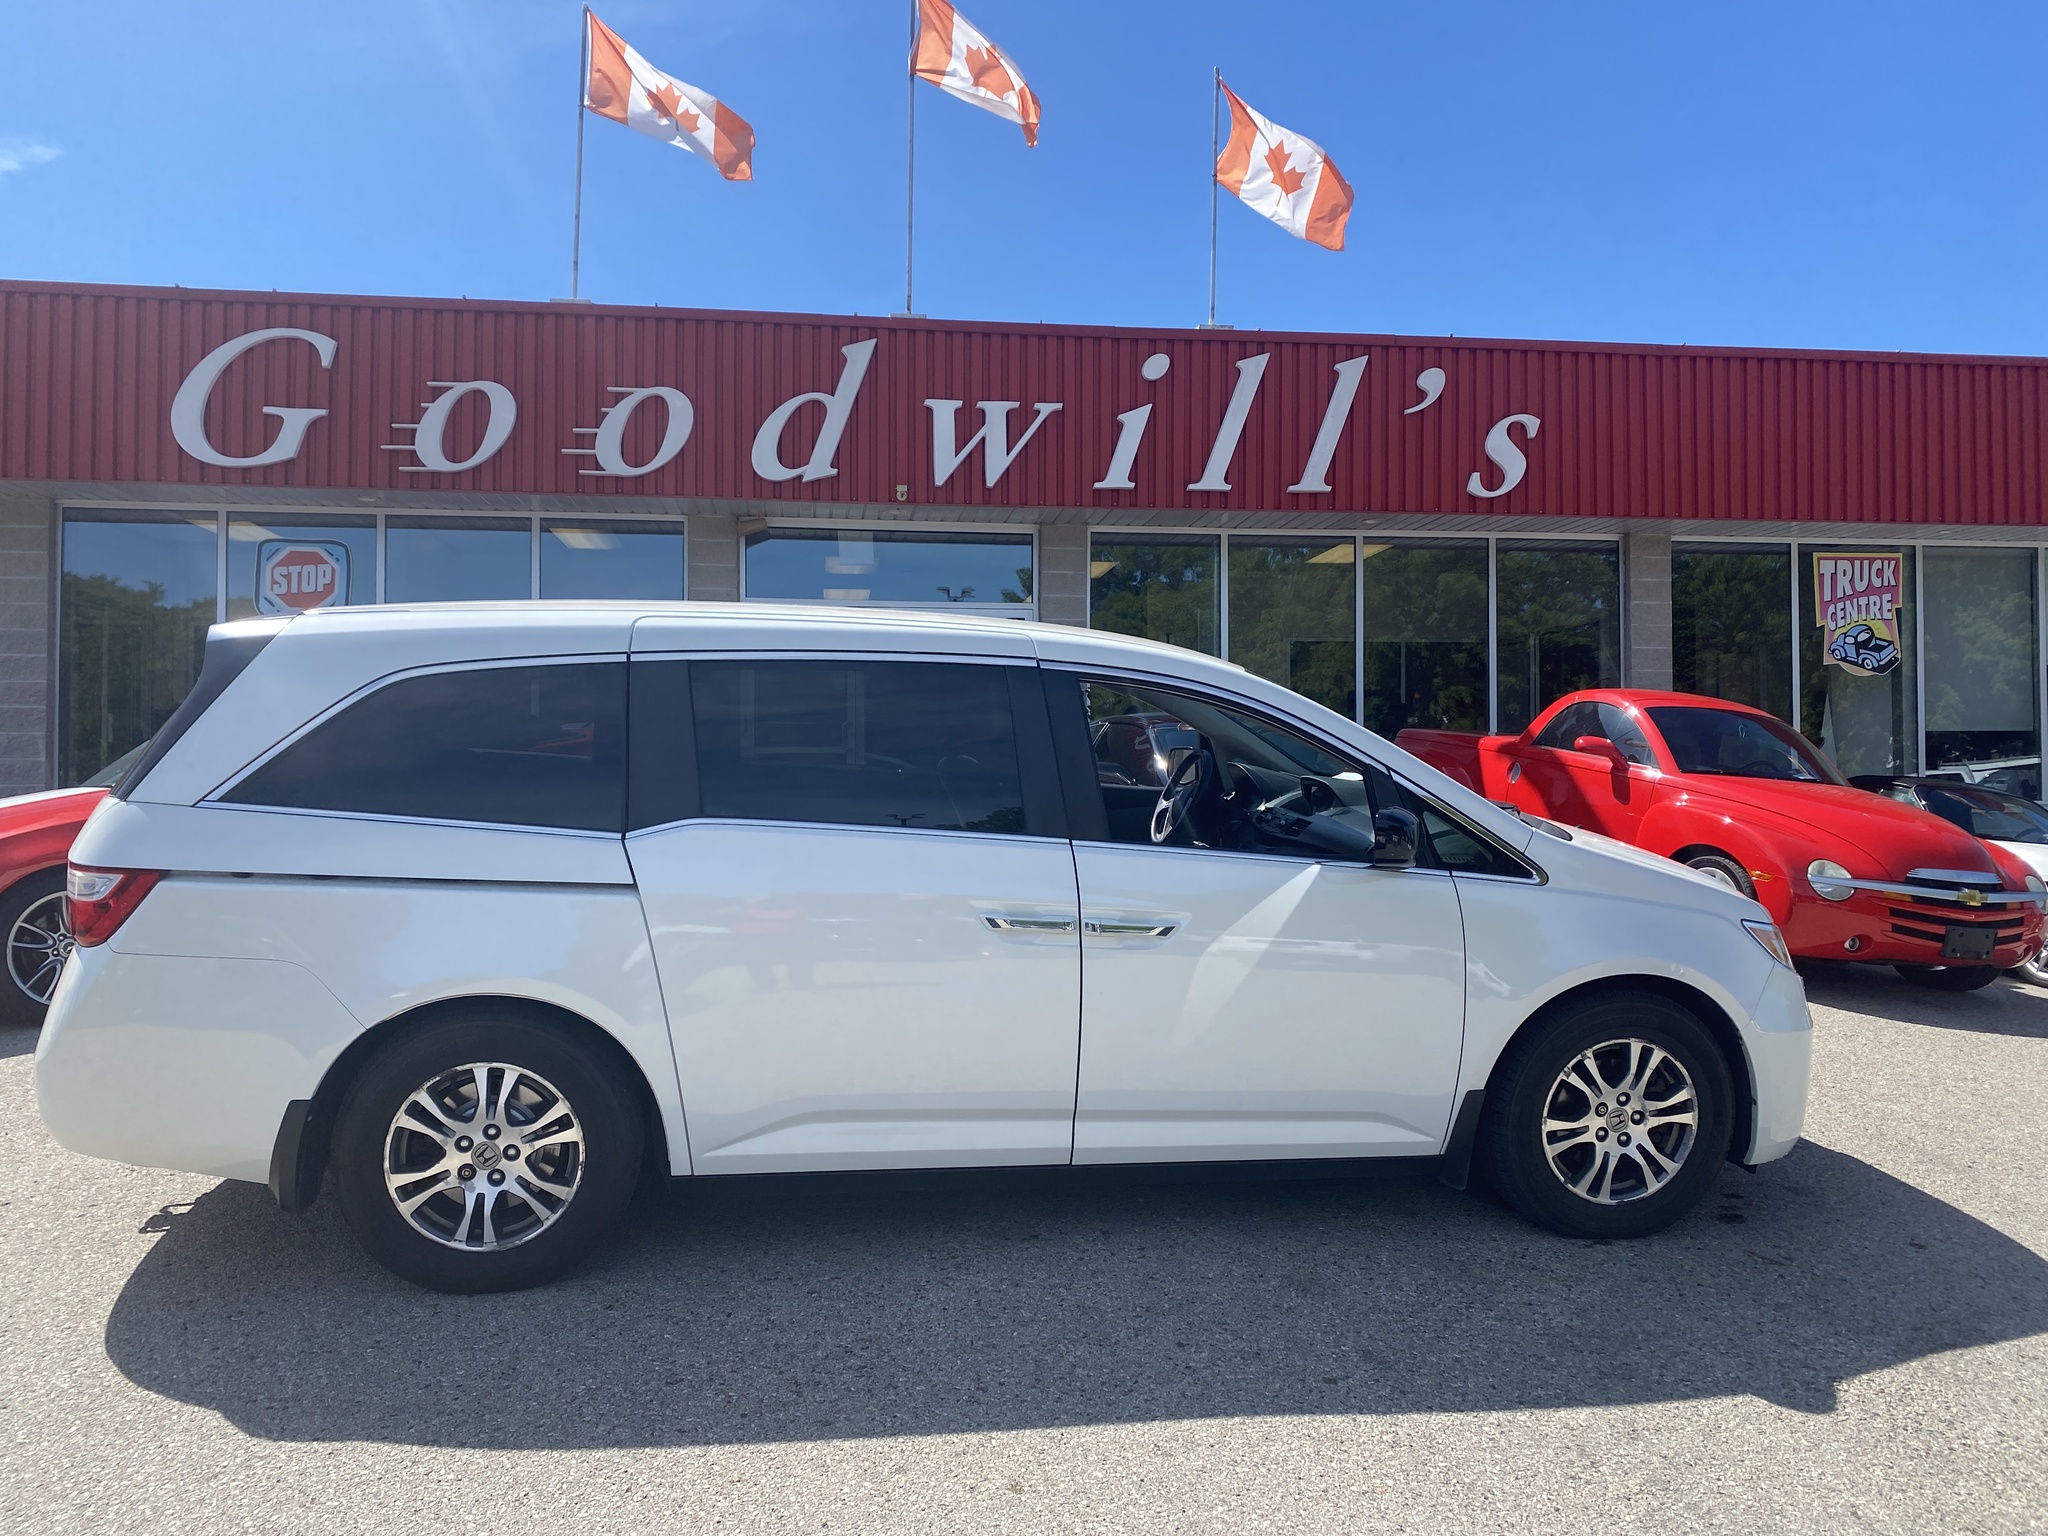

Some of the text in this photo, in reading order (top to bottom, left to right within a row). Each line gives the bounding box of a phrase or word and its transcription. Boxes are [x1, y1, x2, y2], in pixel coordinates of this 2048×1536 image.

[170, 327, 1541, 498] Goodwill's
[272, 563, 332, 595] STOP
[1819, 559, 1897, 602] TRUCK
[1826, 593, 1893, 631] CENTRE
